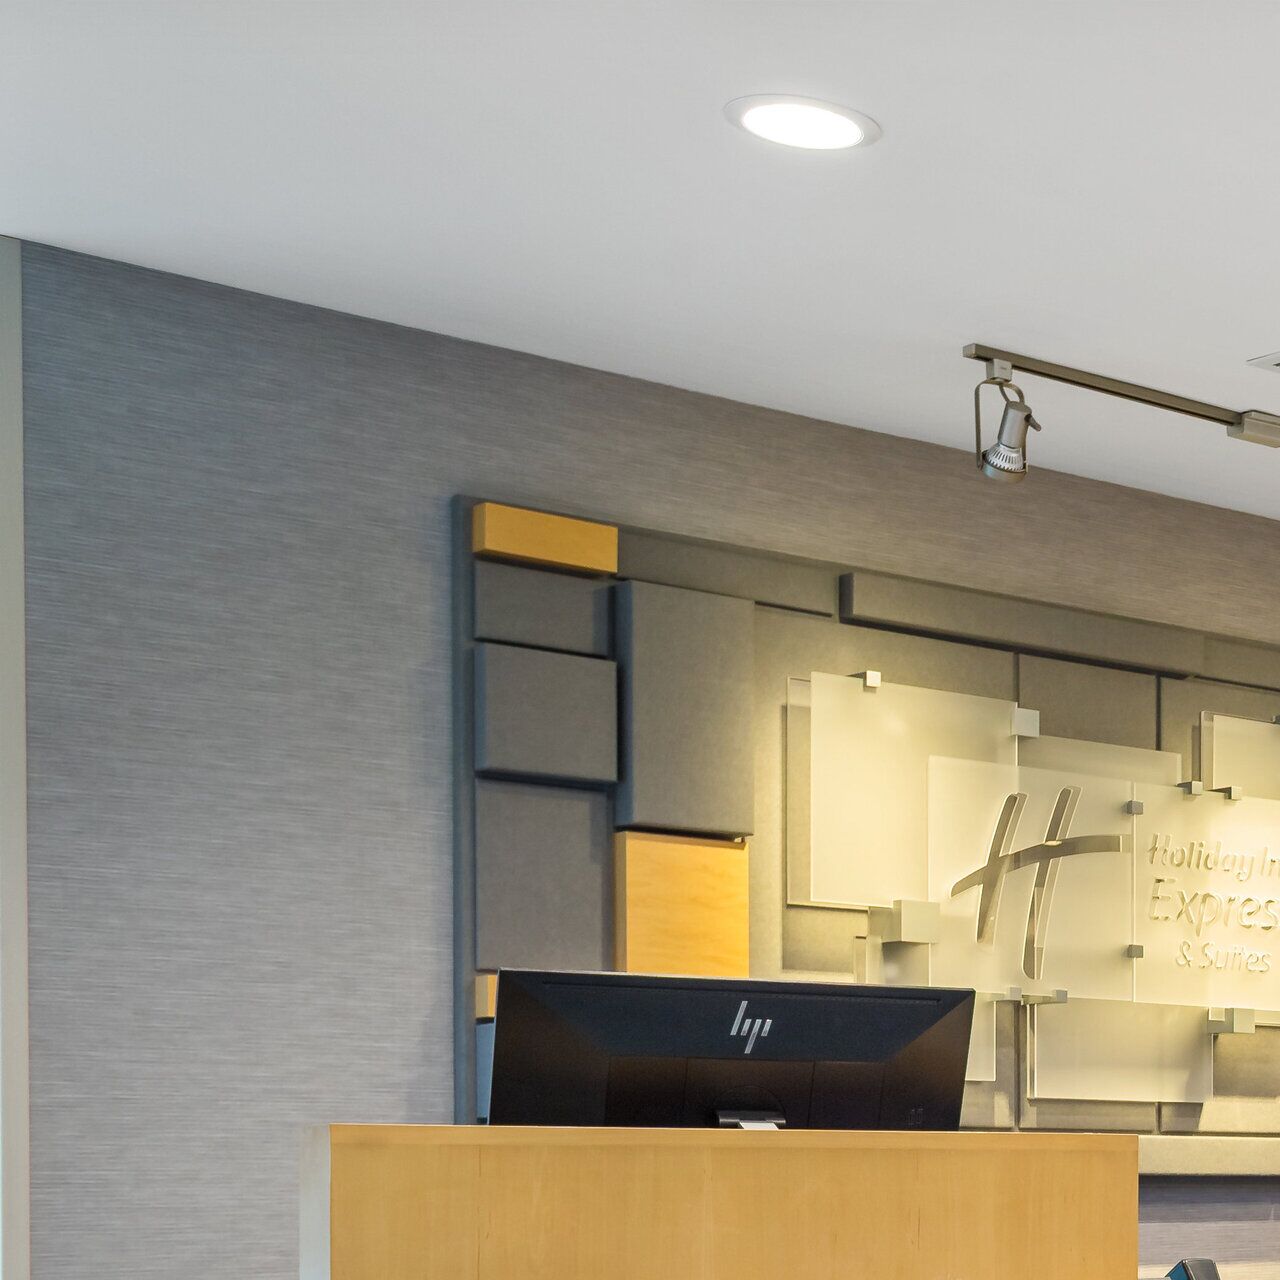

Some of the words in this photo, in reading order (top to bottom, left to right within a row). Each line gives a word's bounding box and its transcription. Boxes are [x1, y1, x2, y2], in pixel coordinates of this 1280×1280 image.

[1148, 832, 1255, 882] Holiday
[1175, 940, 1193, 968] &
[1198, 941, 1272, 974] Suites
[729, 1000, 773, 1054] hp
